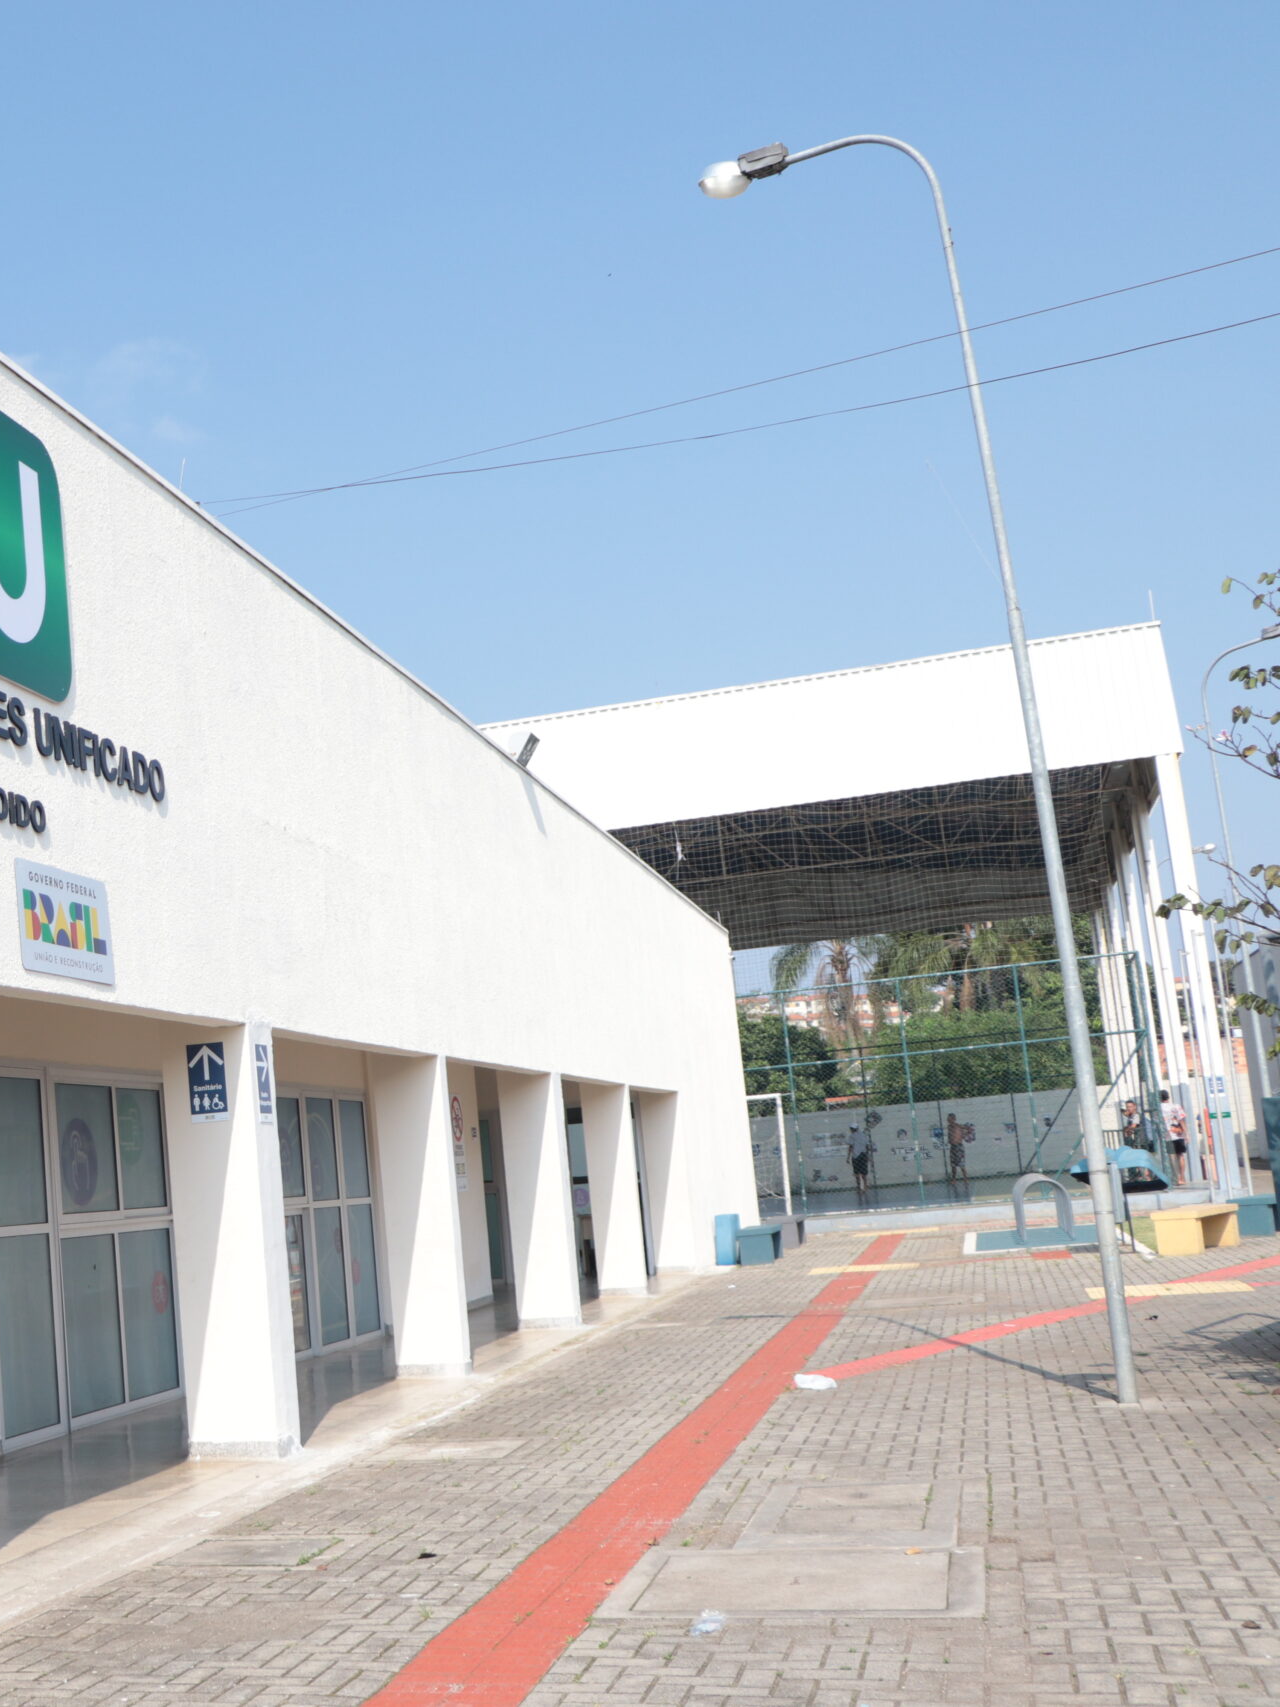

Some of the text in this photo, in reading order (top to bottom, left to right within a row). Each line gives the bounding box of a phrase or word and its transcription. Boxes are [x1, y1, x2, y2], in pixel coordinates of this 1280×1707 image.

[33, 707, 166, 803] UNIFICADO
[28, 871, 97, 899] GOVERNO FEDERAL
[22, 888, 107, 956] BRASIL
[34, 951, 53, 963] UNIÃO
[60, 957, 103, 974] RECONSTRUÇÃO
[193, 1083, 222, 1092] Sanitário
